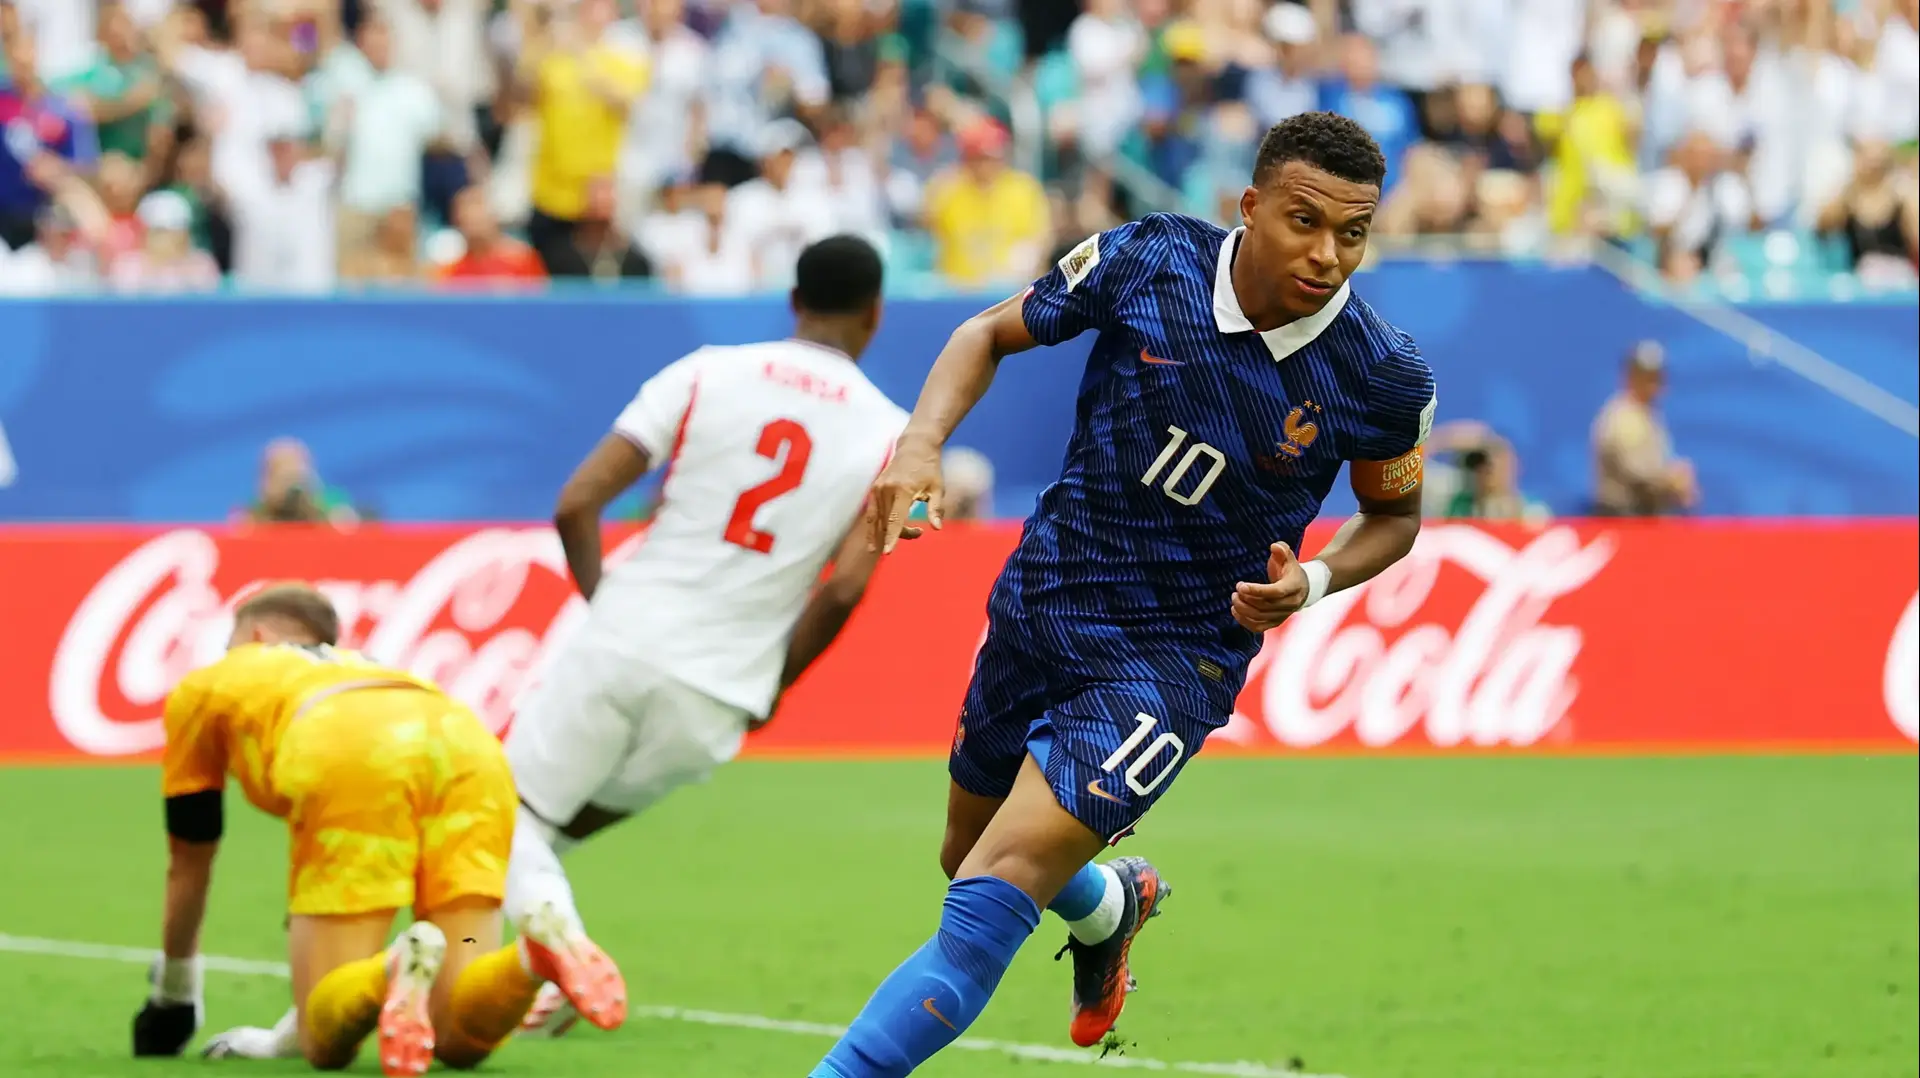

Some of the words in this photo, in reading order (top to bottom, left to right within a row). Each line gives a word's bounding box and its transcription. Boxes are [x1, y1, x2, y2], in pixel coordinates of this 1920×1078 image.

[725, 418, 811, 554] 2
[1140, 424, 1226, 506] 10
[1383, 454, 1421, 481] UNITES
[1100, 711, 1184, 796] 10
